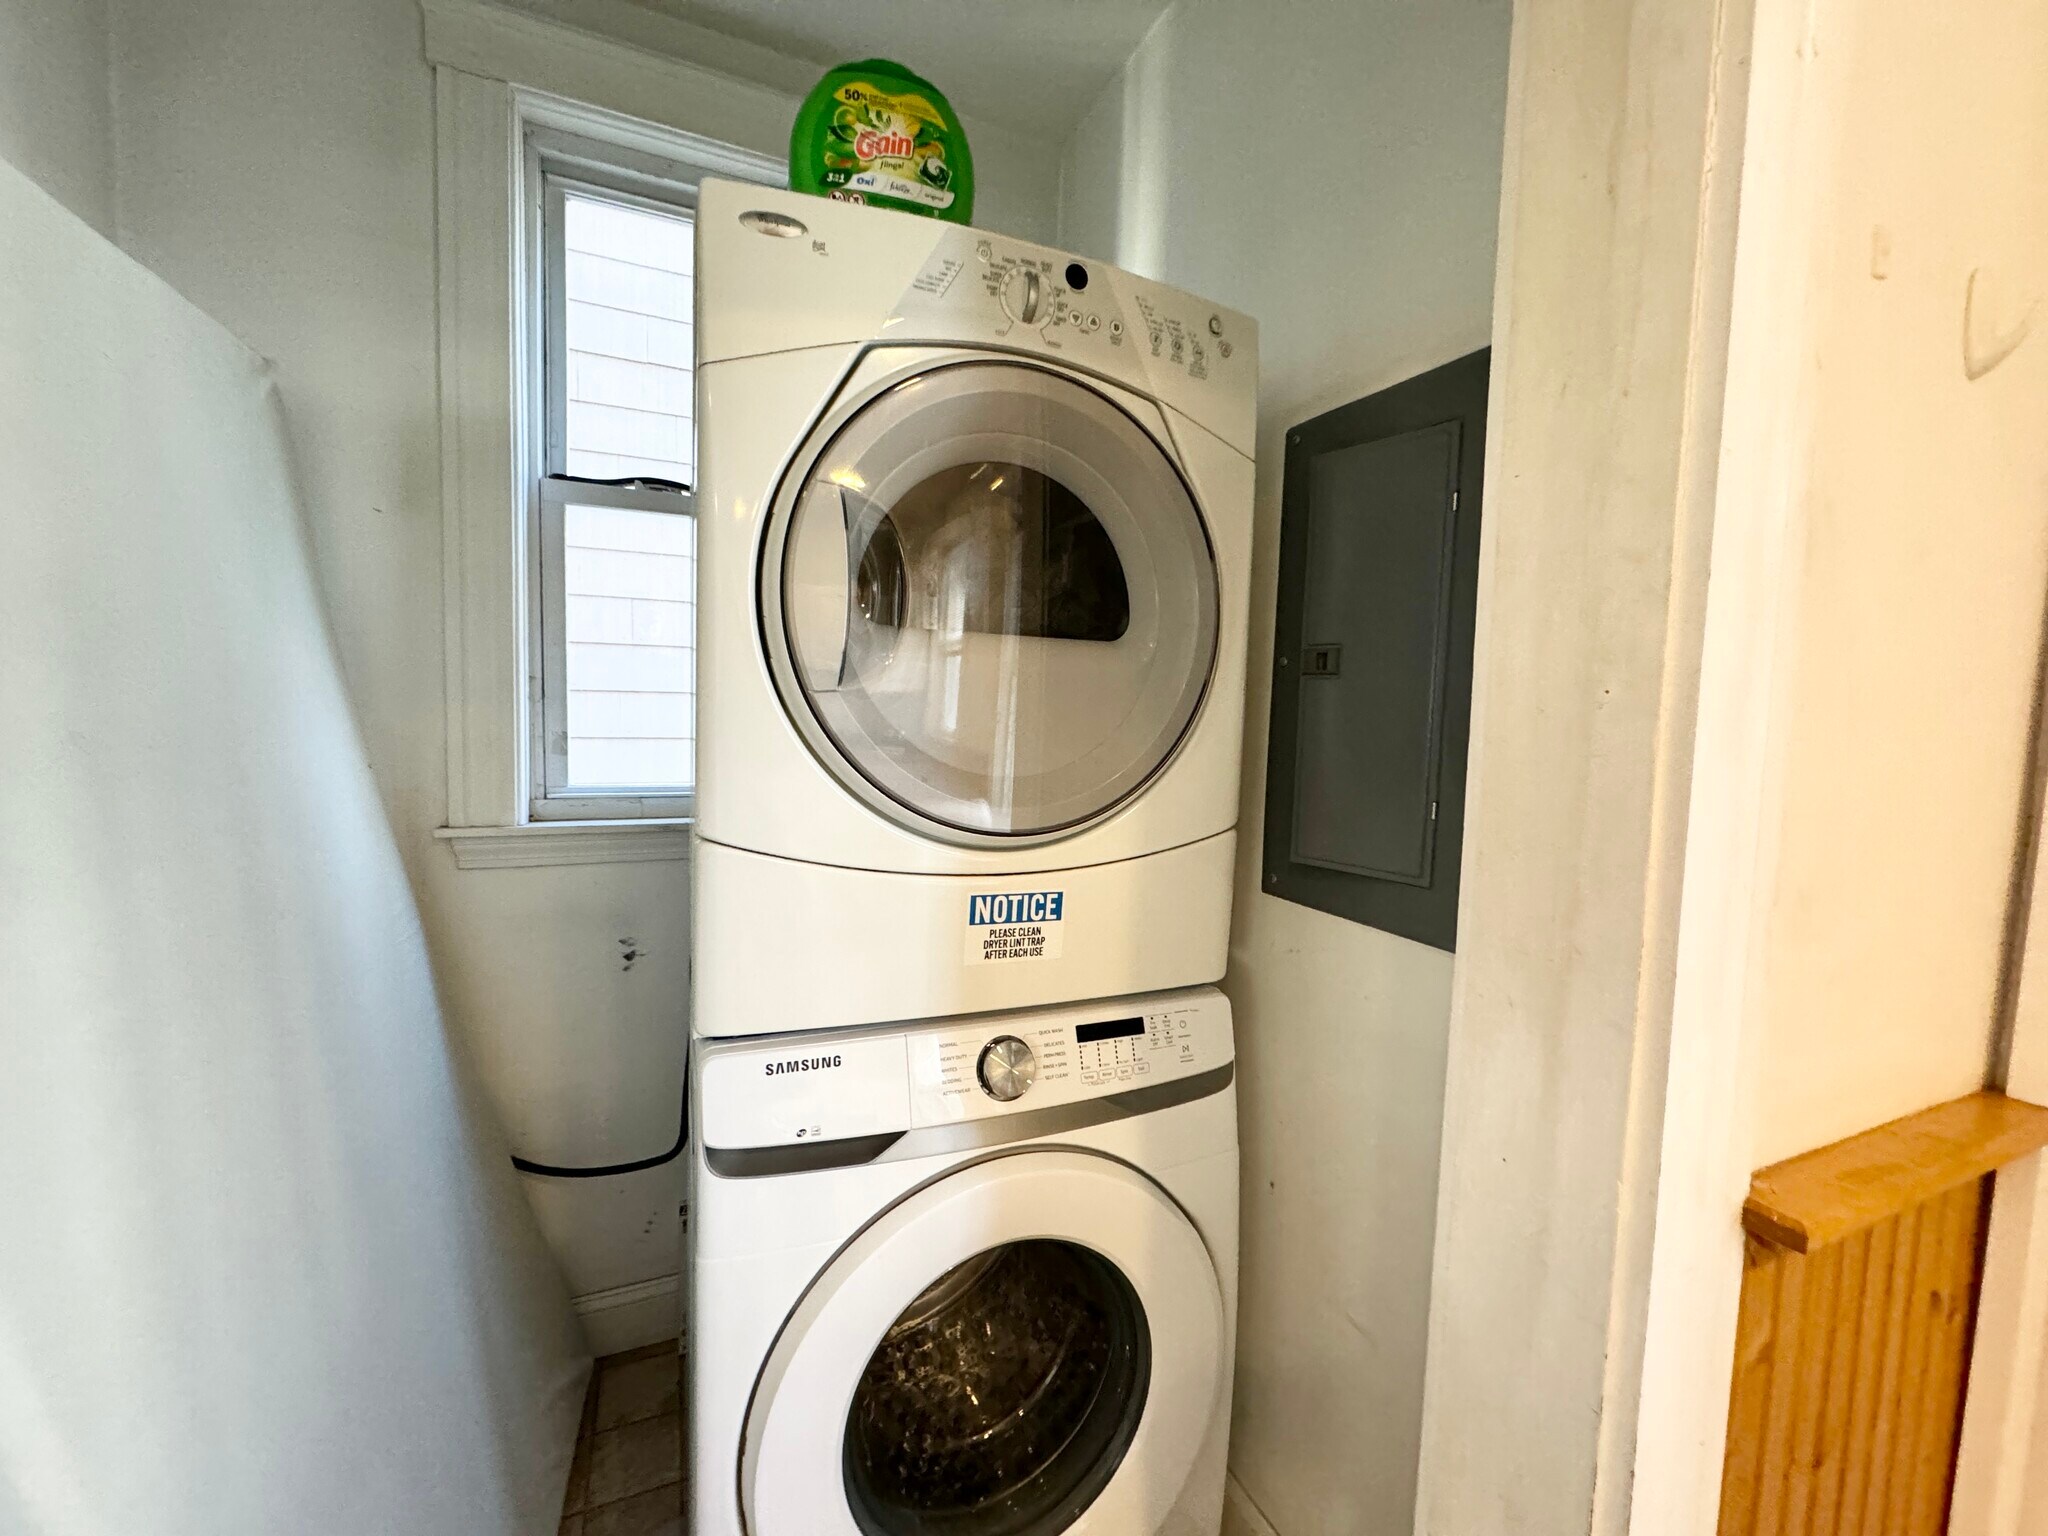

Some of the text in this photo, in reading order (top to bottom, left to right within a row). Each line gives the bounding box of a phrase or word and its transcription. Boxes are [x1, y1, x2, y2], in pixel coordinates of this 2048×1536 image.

[855, 130, 913, 160] Gain
[974, 893, 1059, 924] NOTICE
[989, 926, 1041, 939] PLEASE CLEAN
[983, 936, 1046, 950] DRYER LINT TRAP
[984, 946, 1044, 960] AFTER EACH USE
[765, 1055, 842, 1076] SAMSUNG
